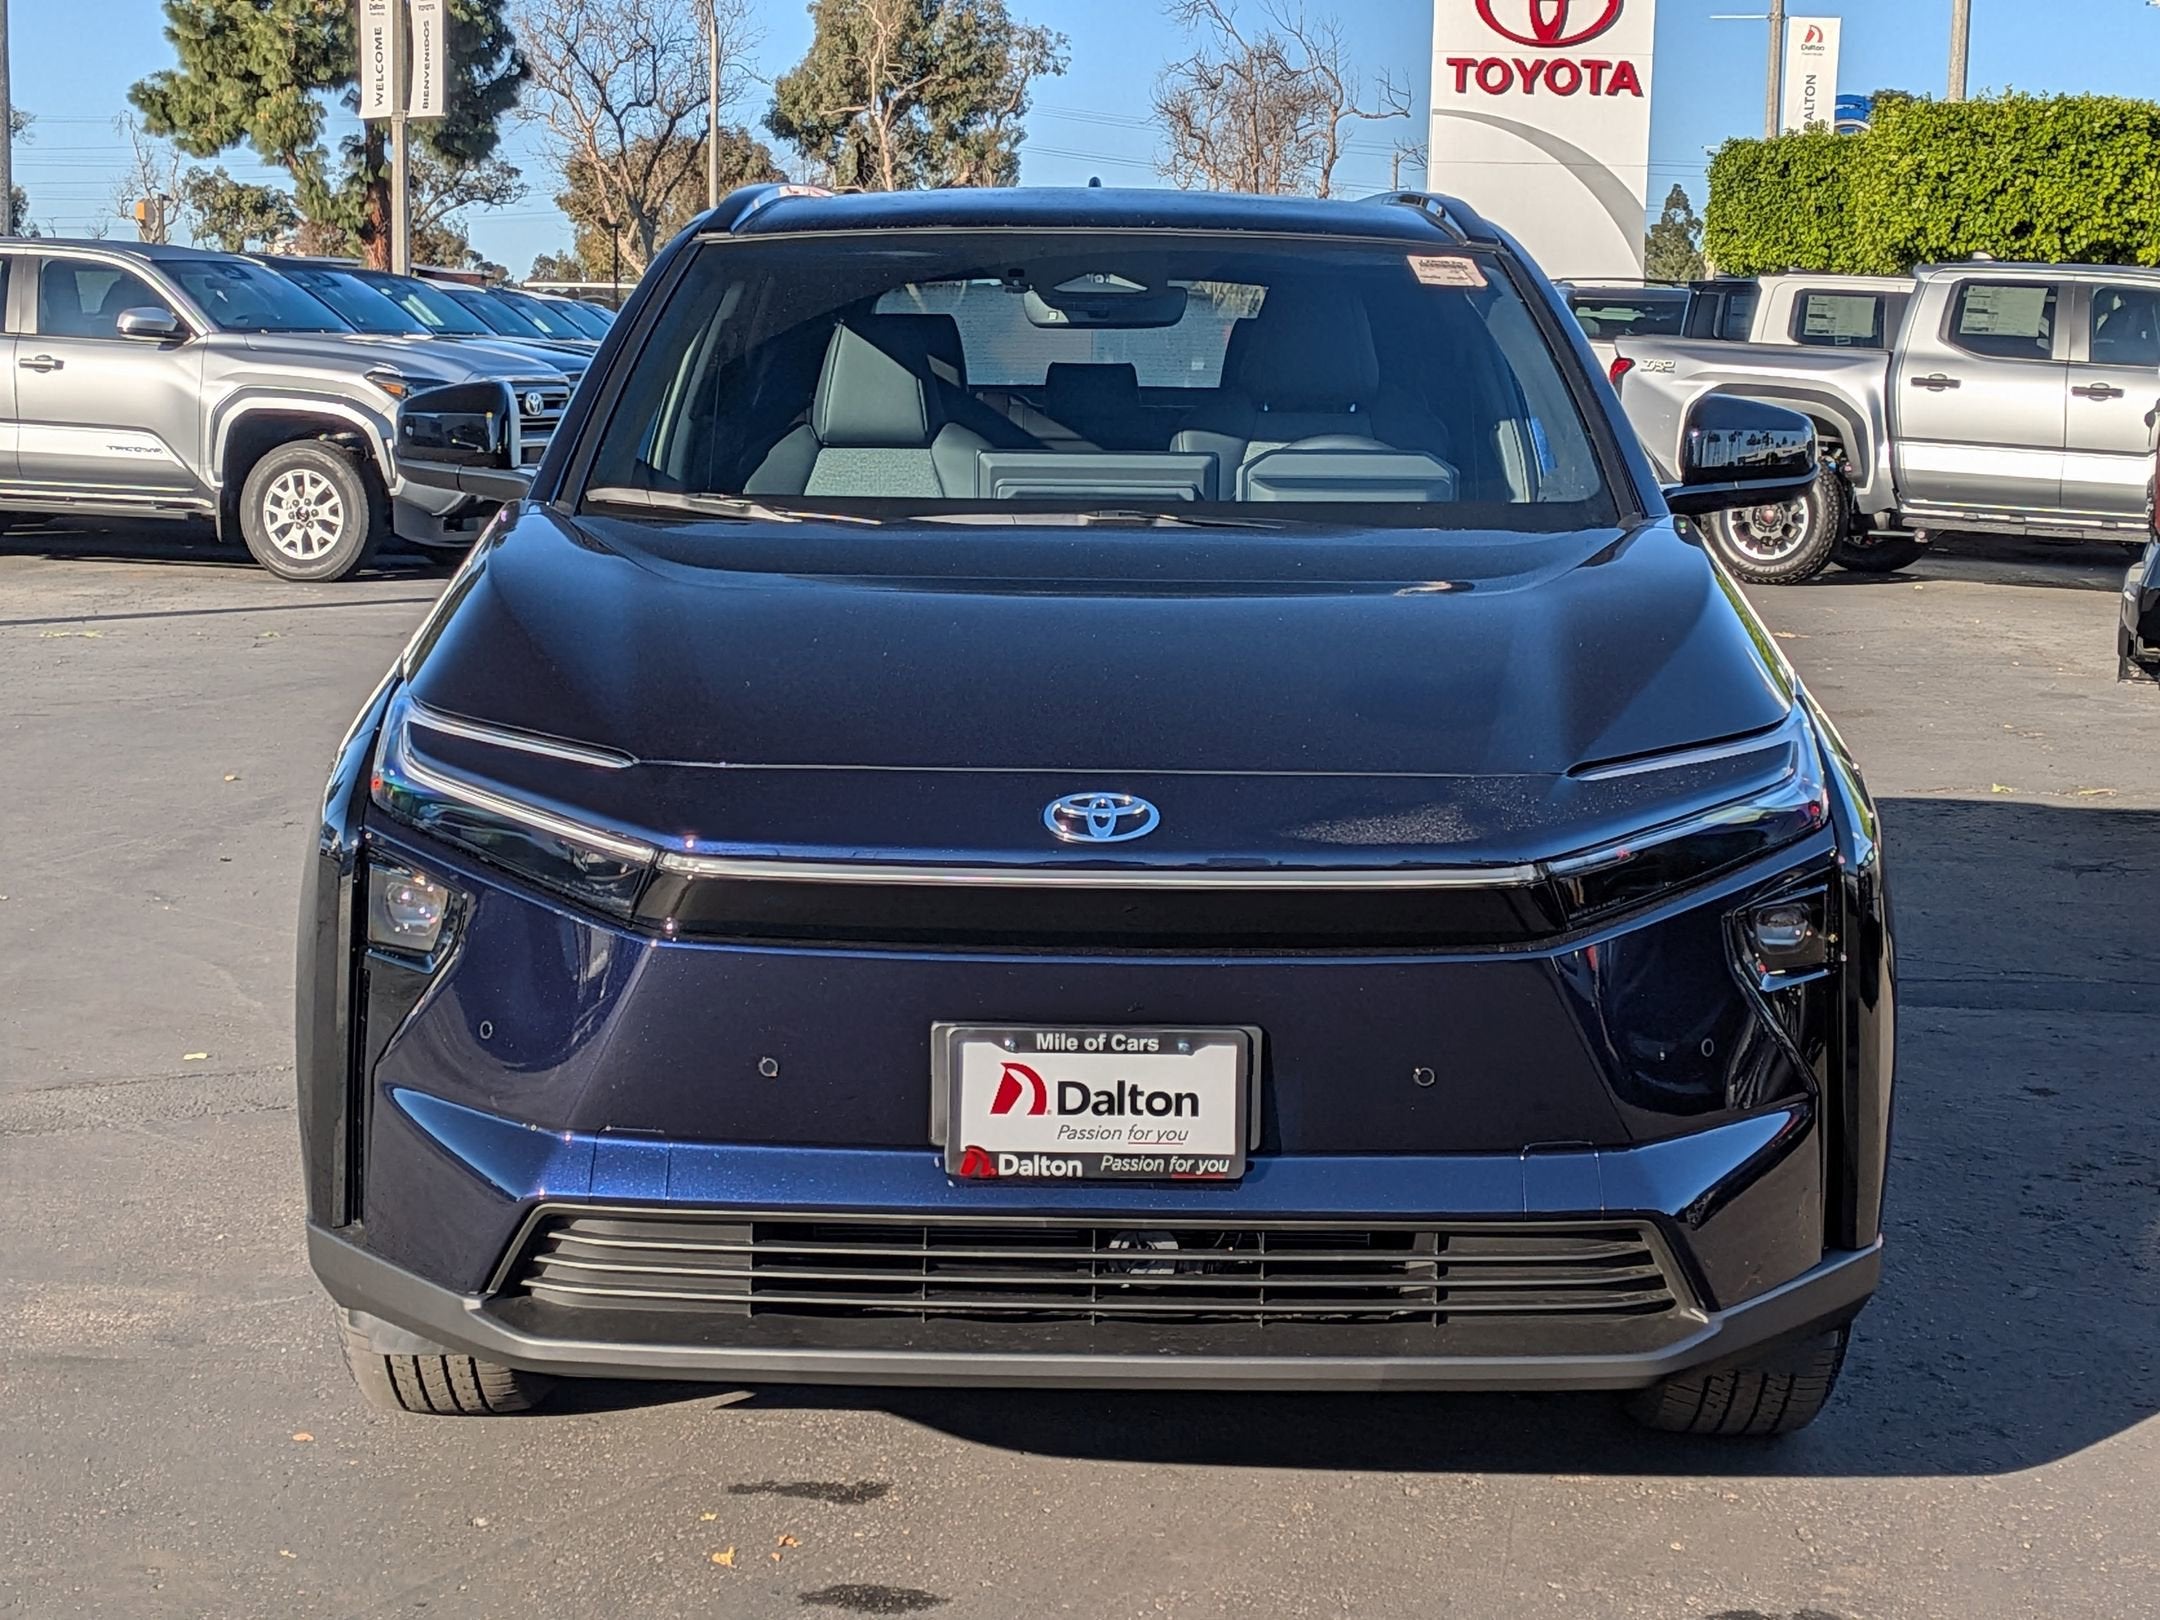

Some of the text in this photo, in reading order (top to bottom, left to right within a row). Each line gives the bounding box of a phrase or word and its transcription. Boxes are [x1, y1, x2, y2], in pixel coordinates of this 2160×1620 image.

[374, 27, 384, 107] WELCOME
[422, 20, 430, 109] BIENVENIDOS
[1446, 57, 1644, 97] TOYOTA
[1036, 1033, 1159, 1052] Mile of Cars
[1057, 1080, 1200, 1117] Dalton
[1057, 1123, 1189, 1143] Passion for you
[998, 1154, 1230, 1177] Dalton Passion for you
